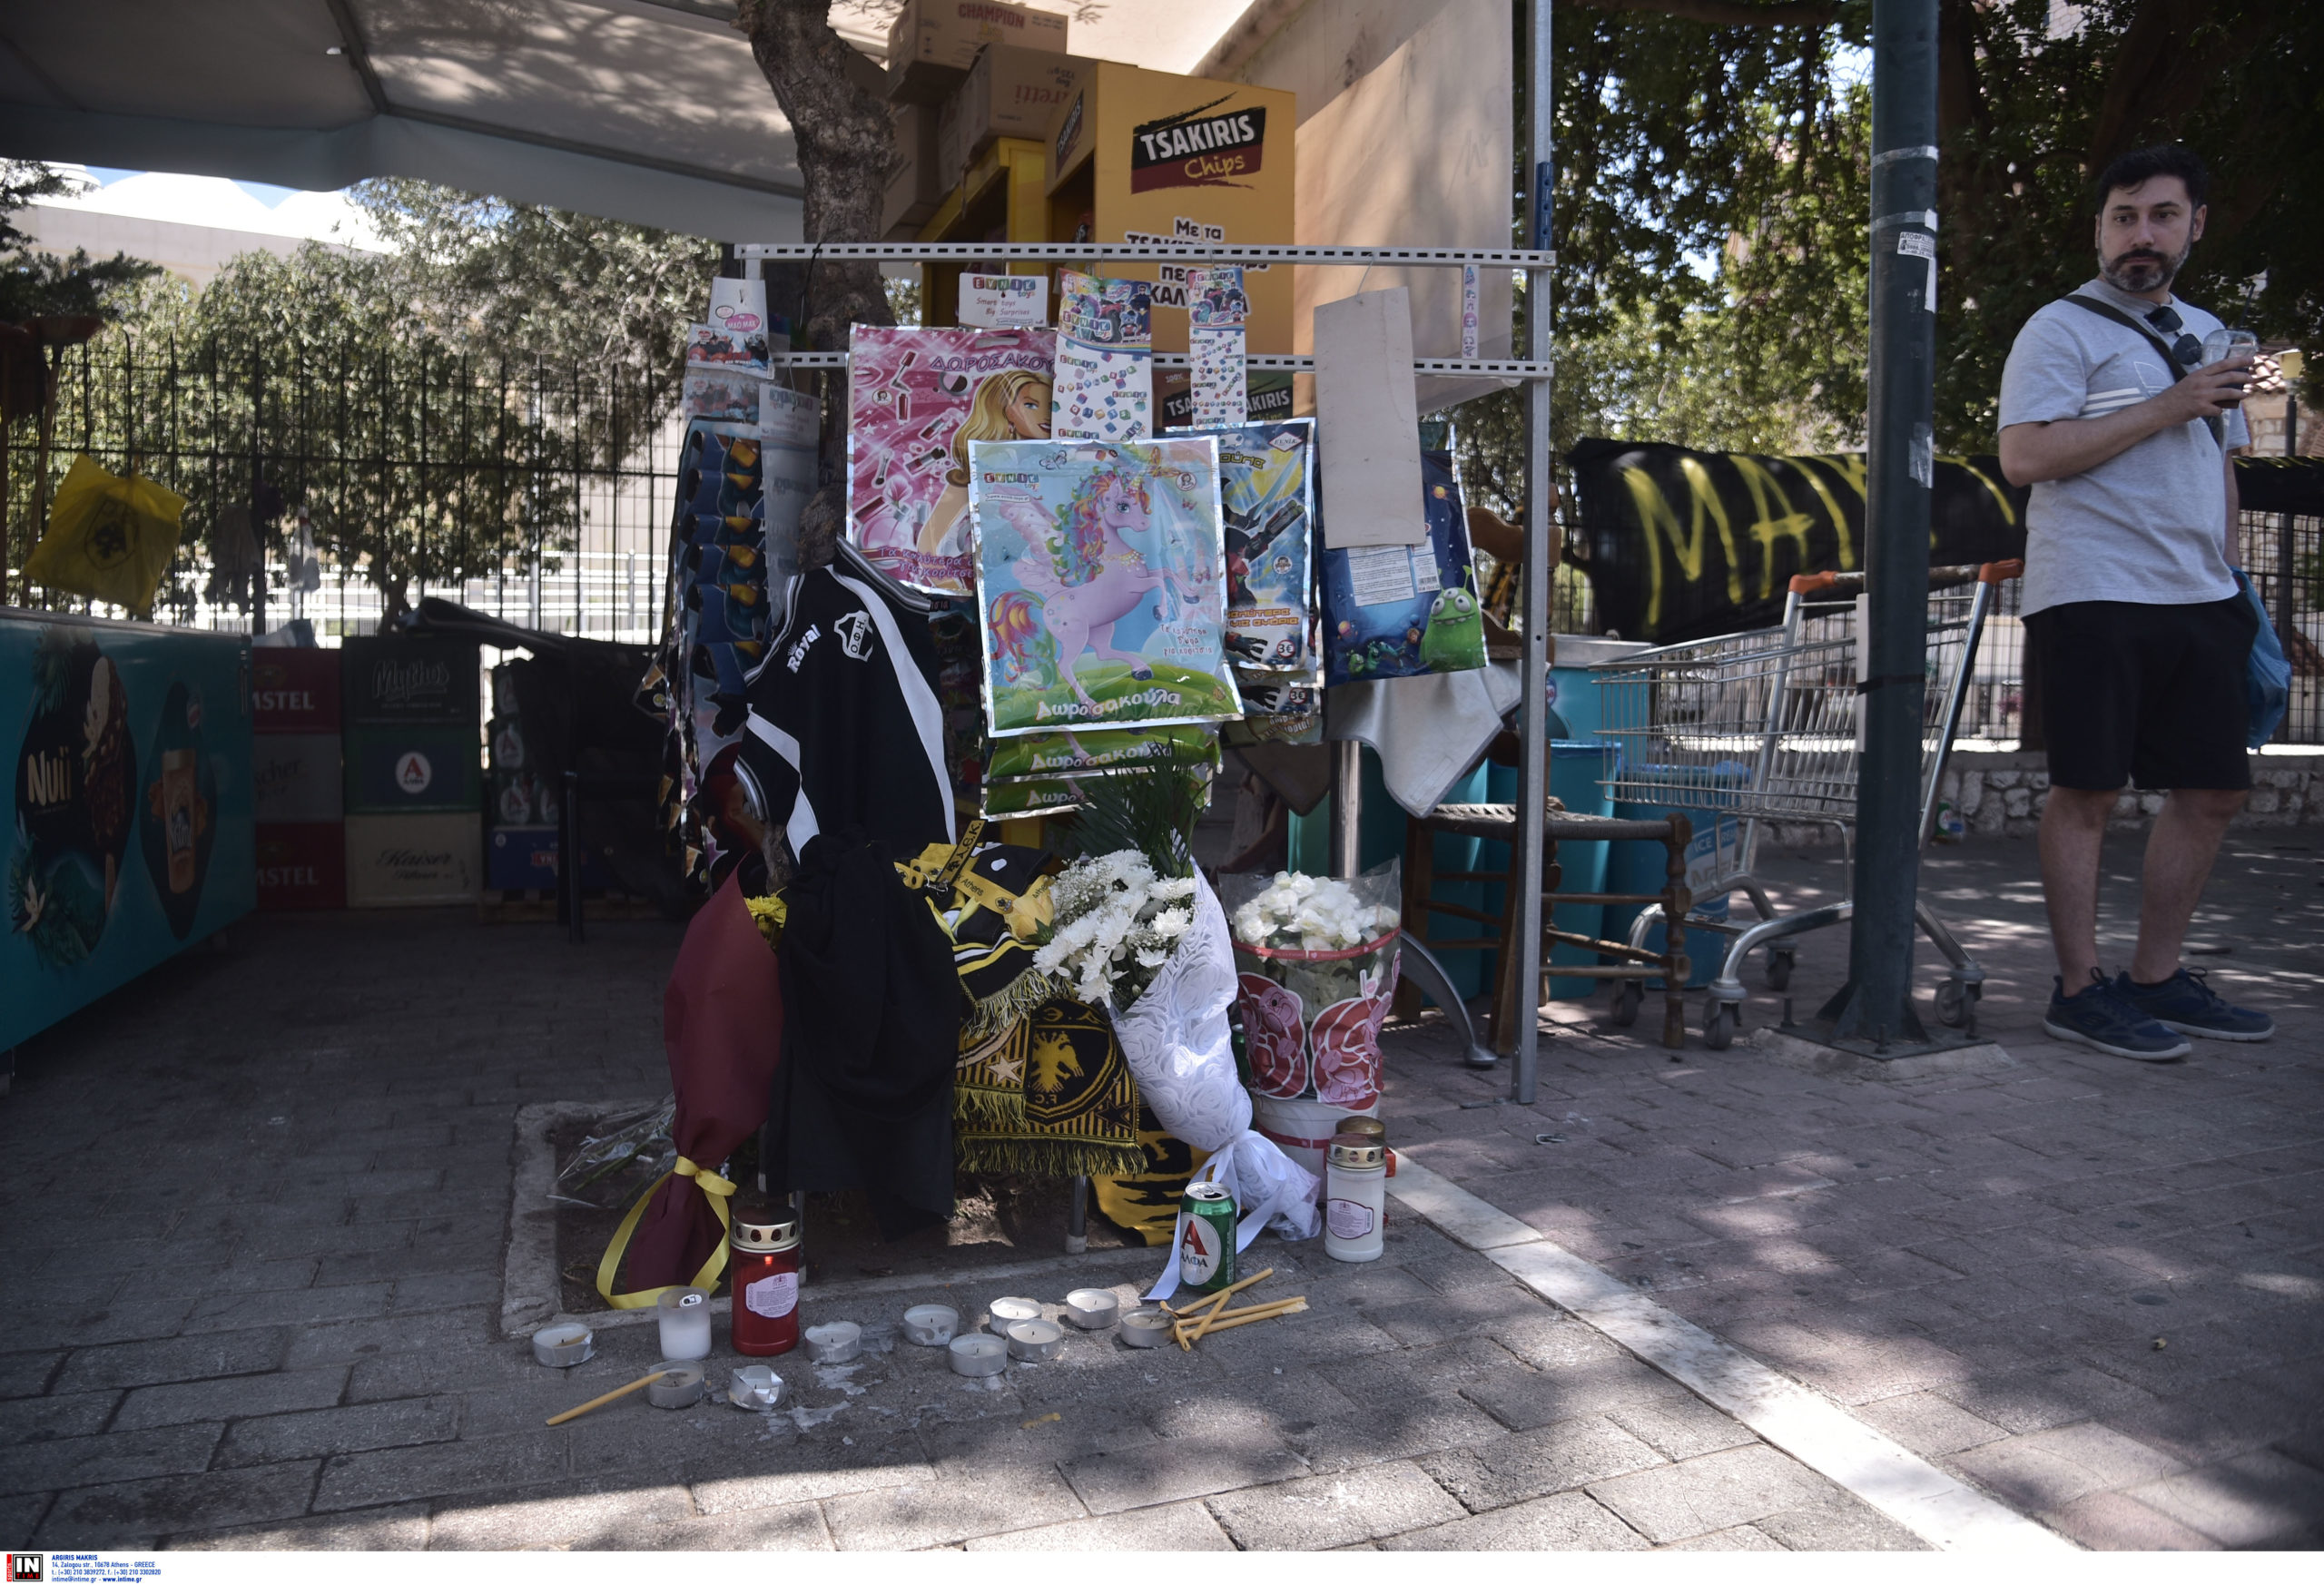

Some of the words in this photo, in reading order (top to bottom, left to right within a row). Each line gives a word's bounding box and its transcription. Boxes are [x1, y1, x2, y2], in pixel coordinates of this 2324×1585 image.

[958, 4, 1025, 29] CHAMPION
[1140, 113, 1256, 162] TSAKIRIS
[1184, 153, 1246, 180] Chips
[983, 471, 1040, 484] EVNIK
[786, 624, 822, 674] Royal
[1277, 644, 1294, 654] 3€
[372, 659, 451, 702] Mythos
[1036, 686, 1183, 723] Δωροσακούλα
[1291, 690, 1306, 701] 3€
[1693, 835, 1713, 853] ICE
[960, 878, 985, 897] Athens
